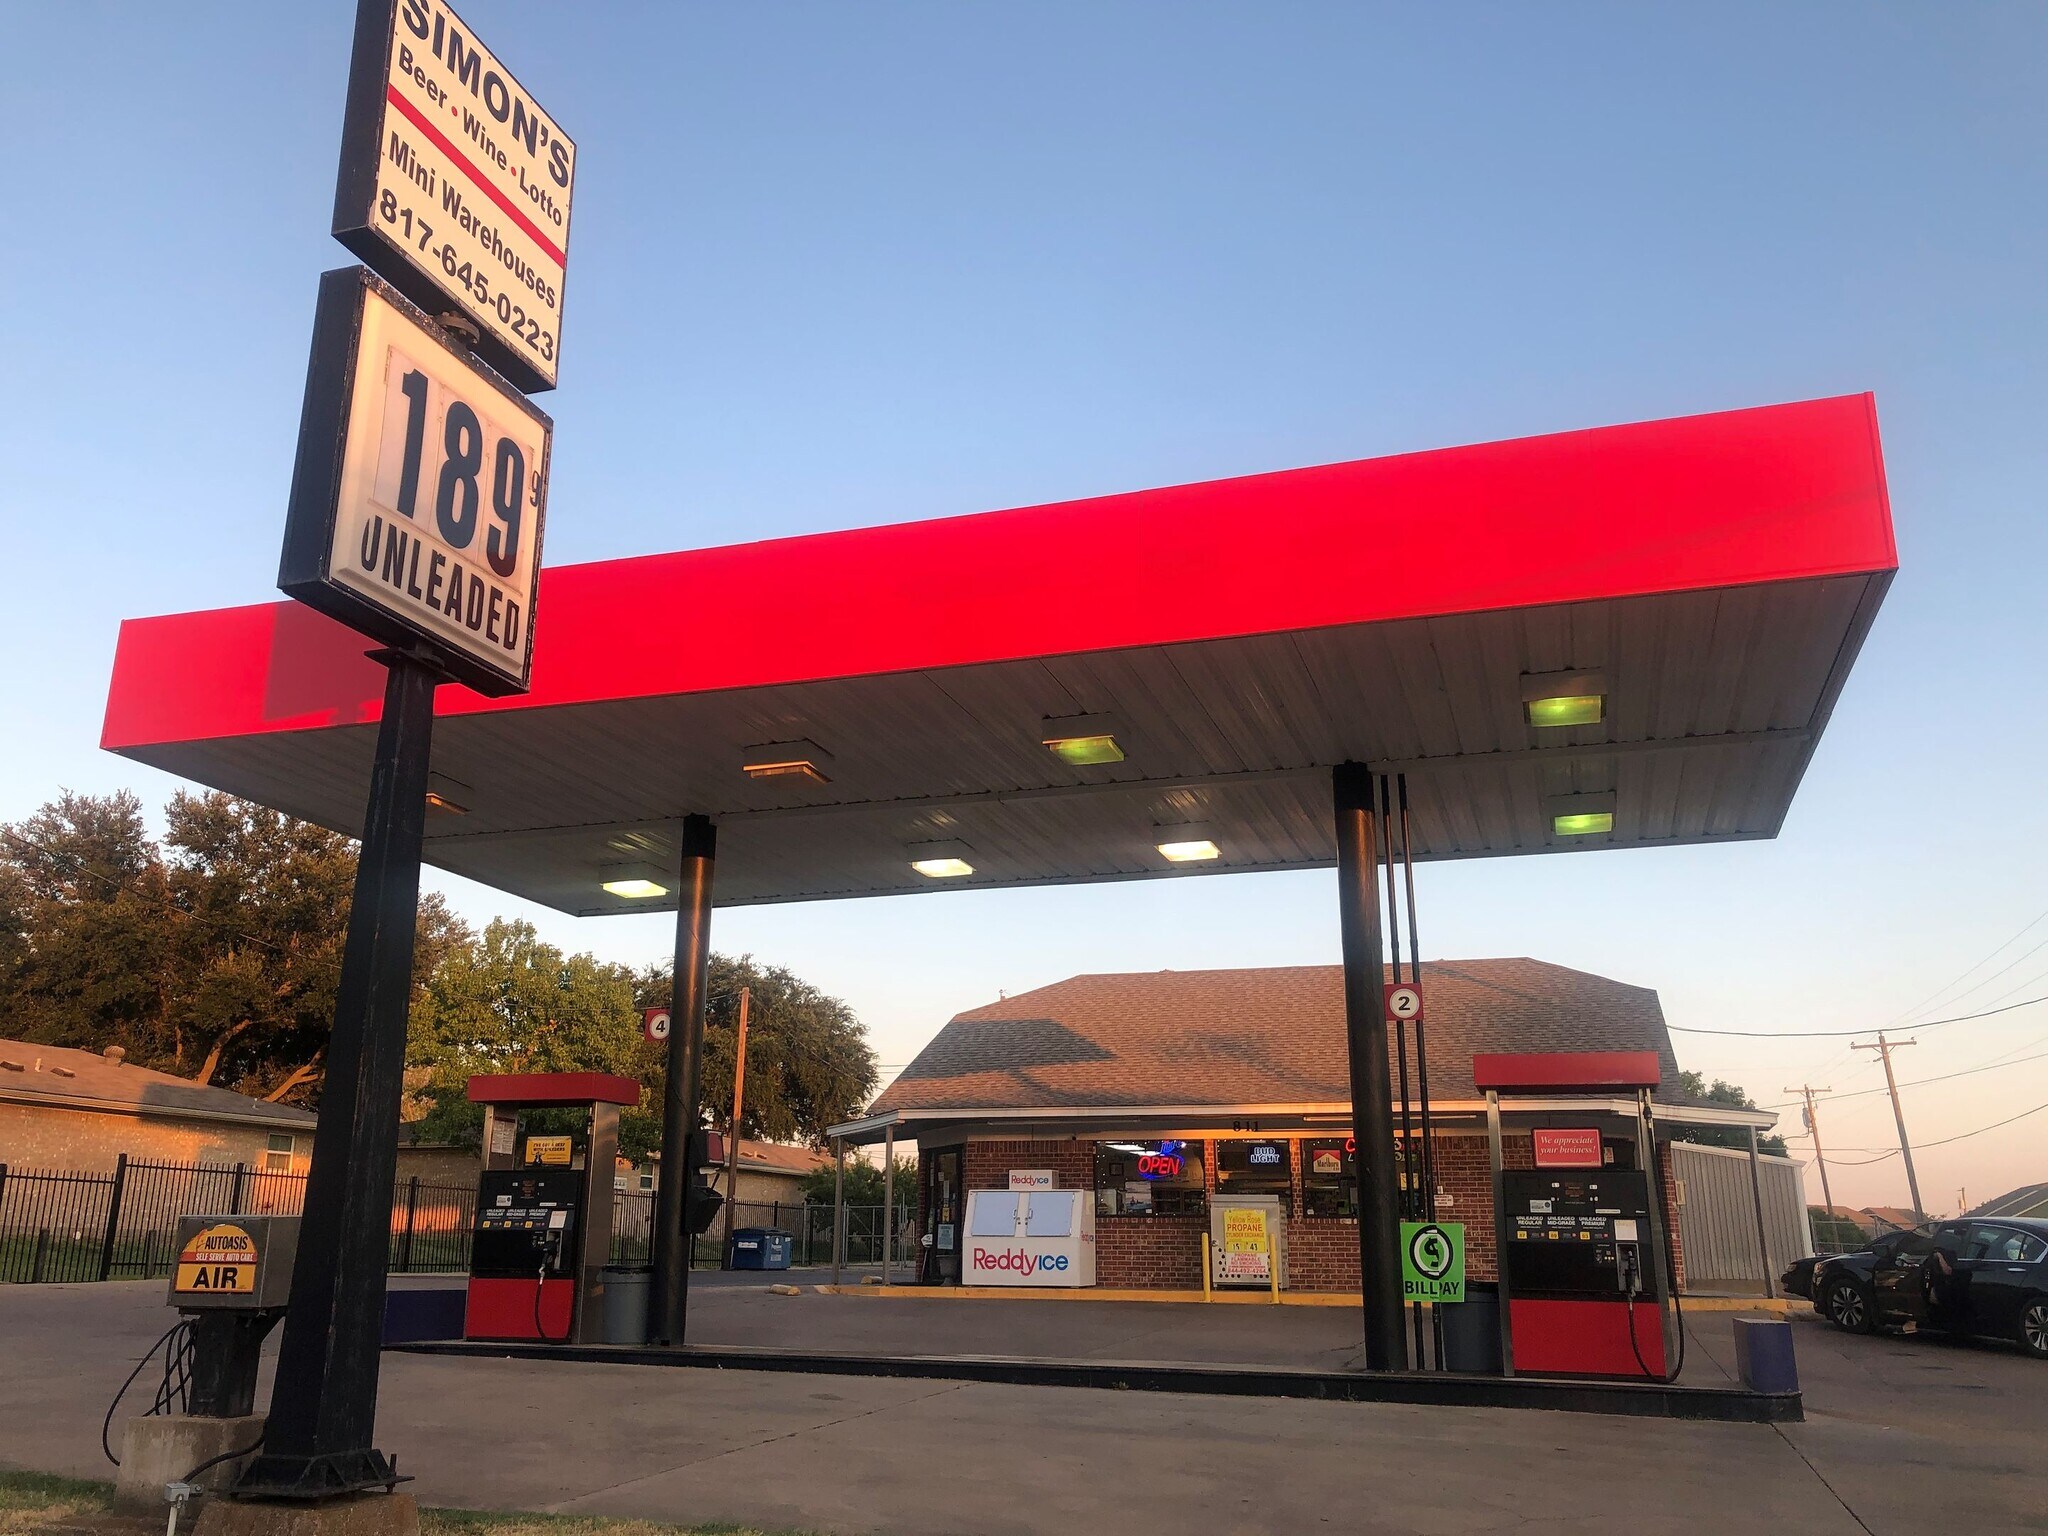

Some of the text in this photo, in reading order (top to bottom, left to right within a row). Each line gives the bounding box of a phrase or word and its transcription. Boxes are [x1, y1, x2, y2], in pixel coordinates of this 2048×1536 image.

[402, 0, 569, 188] SIMON'S
[399, 43, 562, 227] Beer Wine Lotto
[389, 131, 556, 309] Mini Warehouses
[379, 188, 554, 362] 817-645-0223
[396, 368, 526, 578] 189
[360, 515, 520, 652] UNLEADED
[1398, 996, 1411, 1011] 2
[655, 1020, 666, 1033] 4
[1232, 1121, 1260, 1132] 811
[1540, 1136, 1594, 1147] We appreciate
[1253, 1147, 1276, 1155] BUD
[1540, 1145, 1596, 1154] your business!
[1137, 1156, 1180, 1175] OPEN
[1250, 1154, 1280, 1163] LIGHT
[1226, 1223, 1263, 1232] PROPANE
[204, 1235, 248, 1250] AUTOASIS
[195, 1252, 254, 1261] SELF SERVE AUTO CARE
[192, 1266, 238, 1289] AIR
